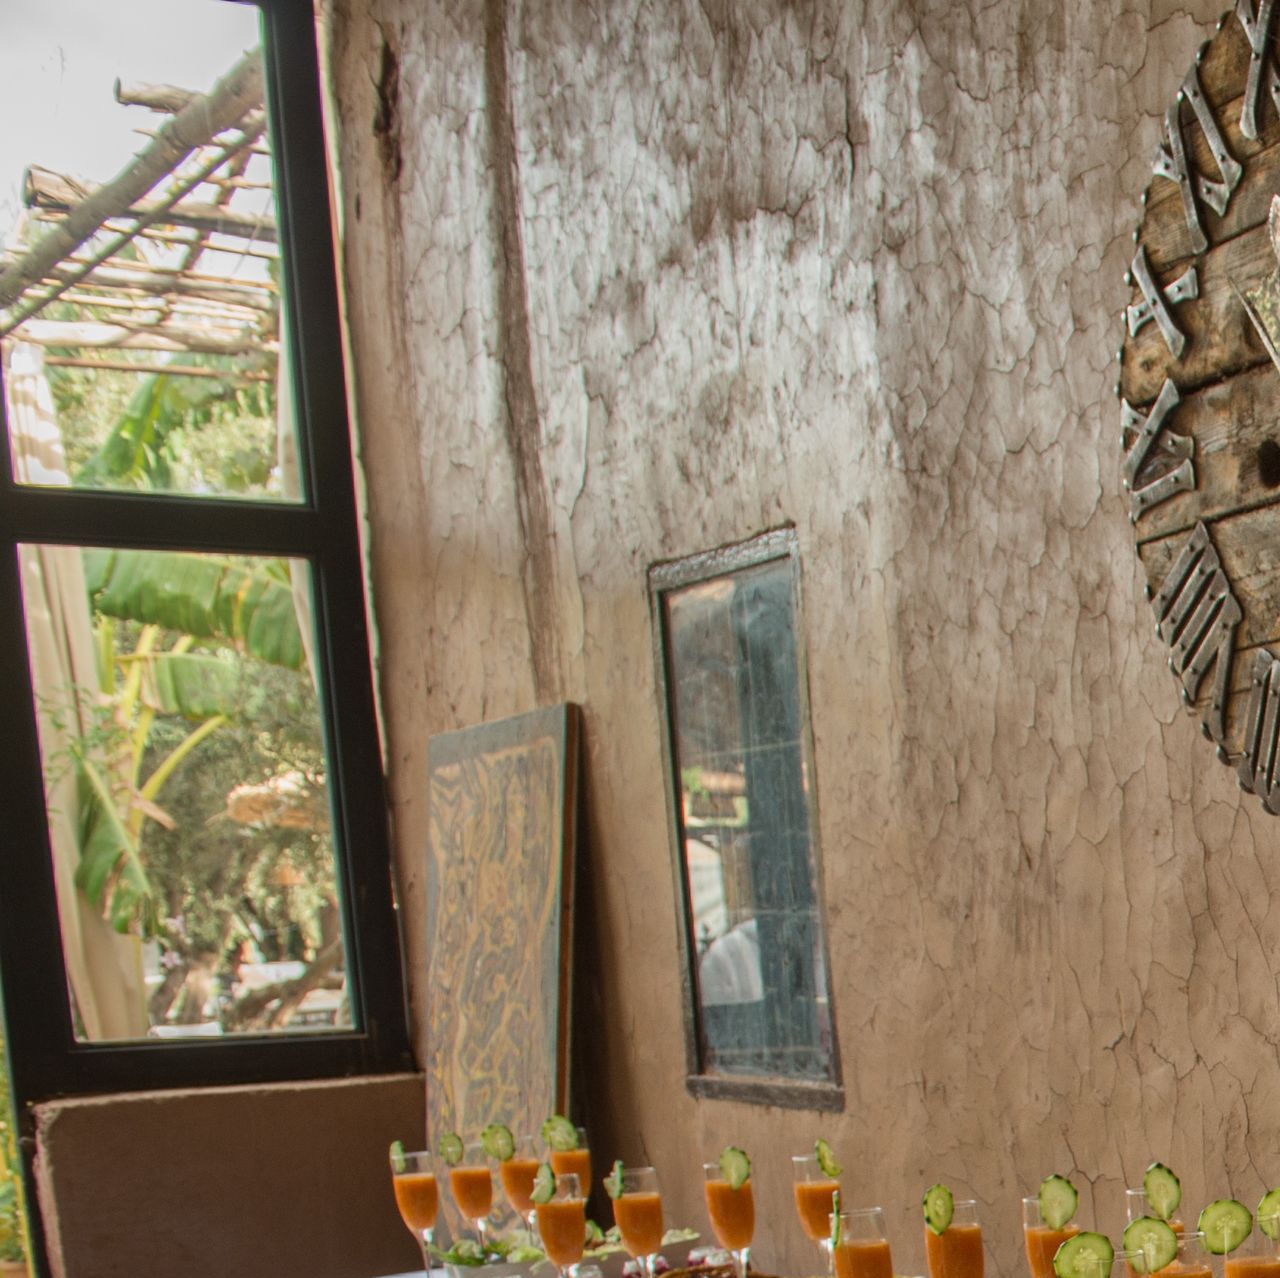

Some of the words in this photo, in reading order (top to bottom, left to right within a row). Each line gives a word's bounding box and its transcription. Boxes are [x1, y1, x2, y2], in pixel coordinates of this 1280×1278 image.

[1152, 63, 1243, 253] XI
[1127, 246, 1199, 360] X
[1120, 377, 1195, 522] IX
[1150, 519, 1242, 743] VIII
